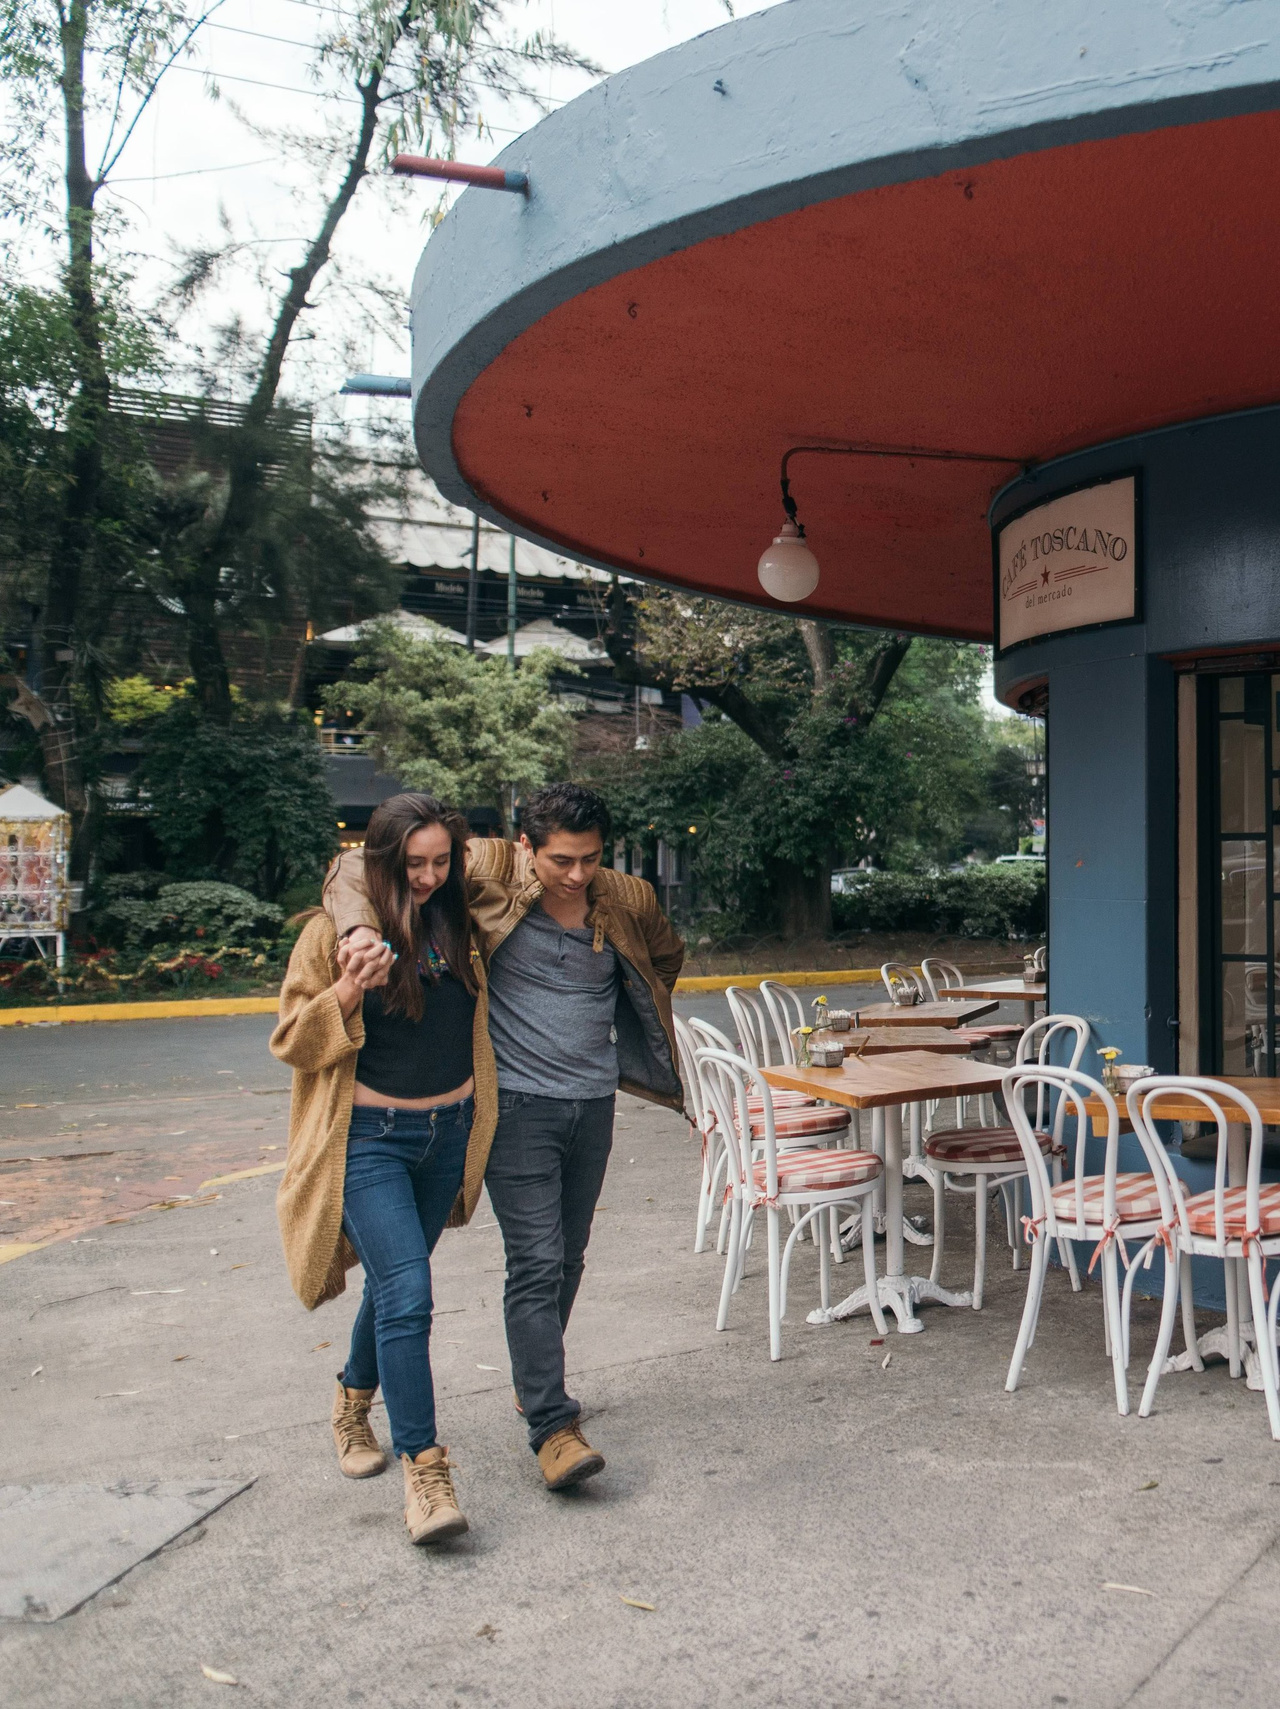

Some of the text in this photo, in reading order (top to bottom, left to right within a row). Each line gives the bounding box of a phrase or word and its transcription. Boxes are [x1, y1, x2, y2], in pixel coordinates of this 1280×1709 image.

[1002, 525, 1128, 599] CAFÉ TOSCANO
[1025, 584, 1073, 609] del mercado
